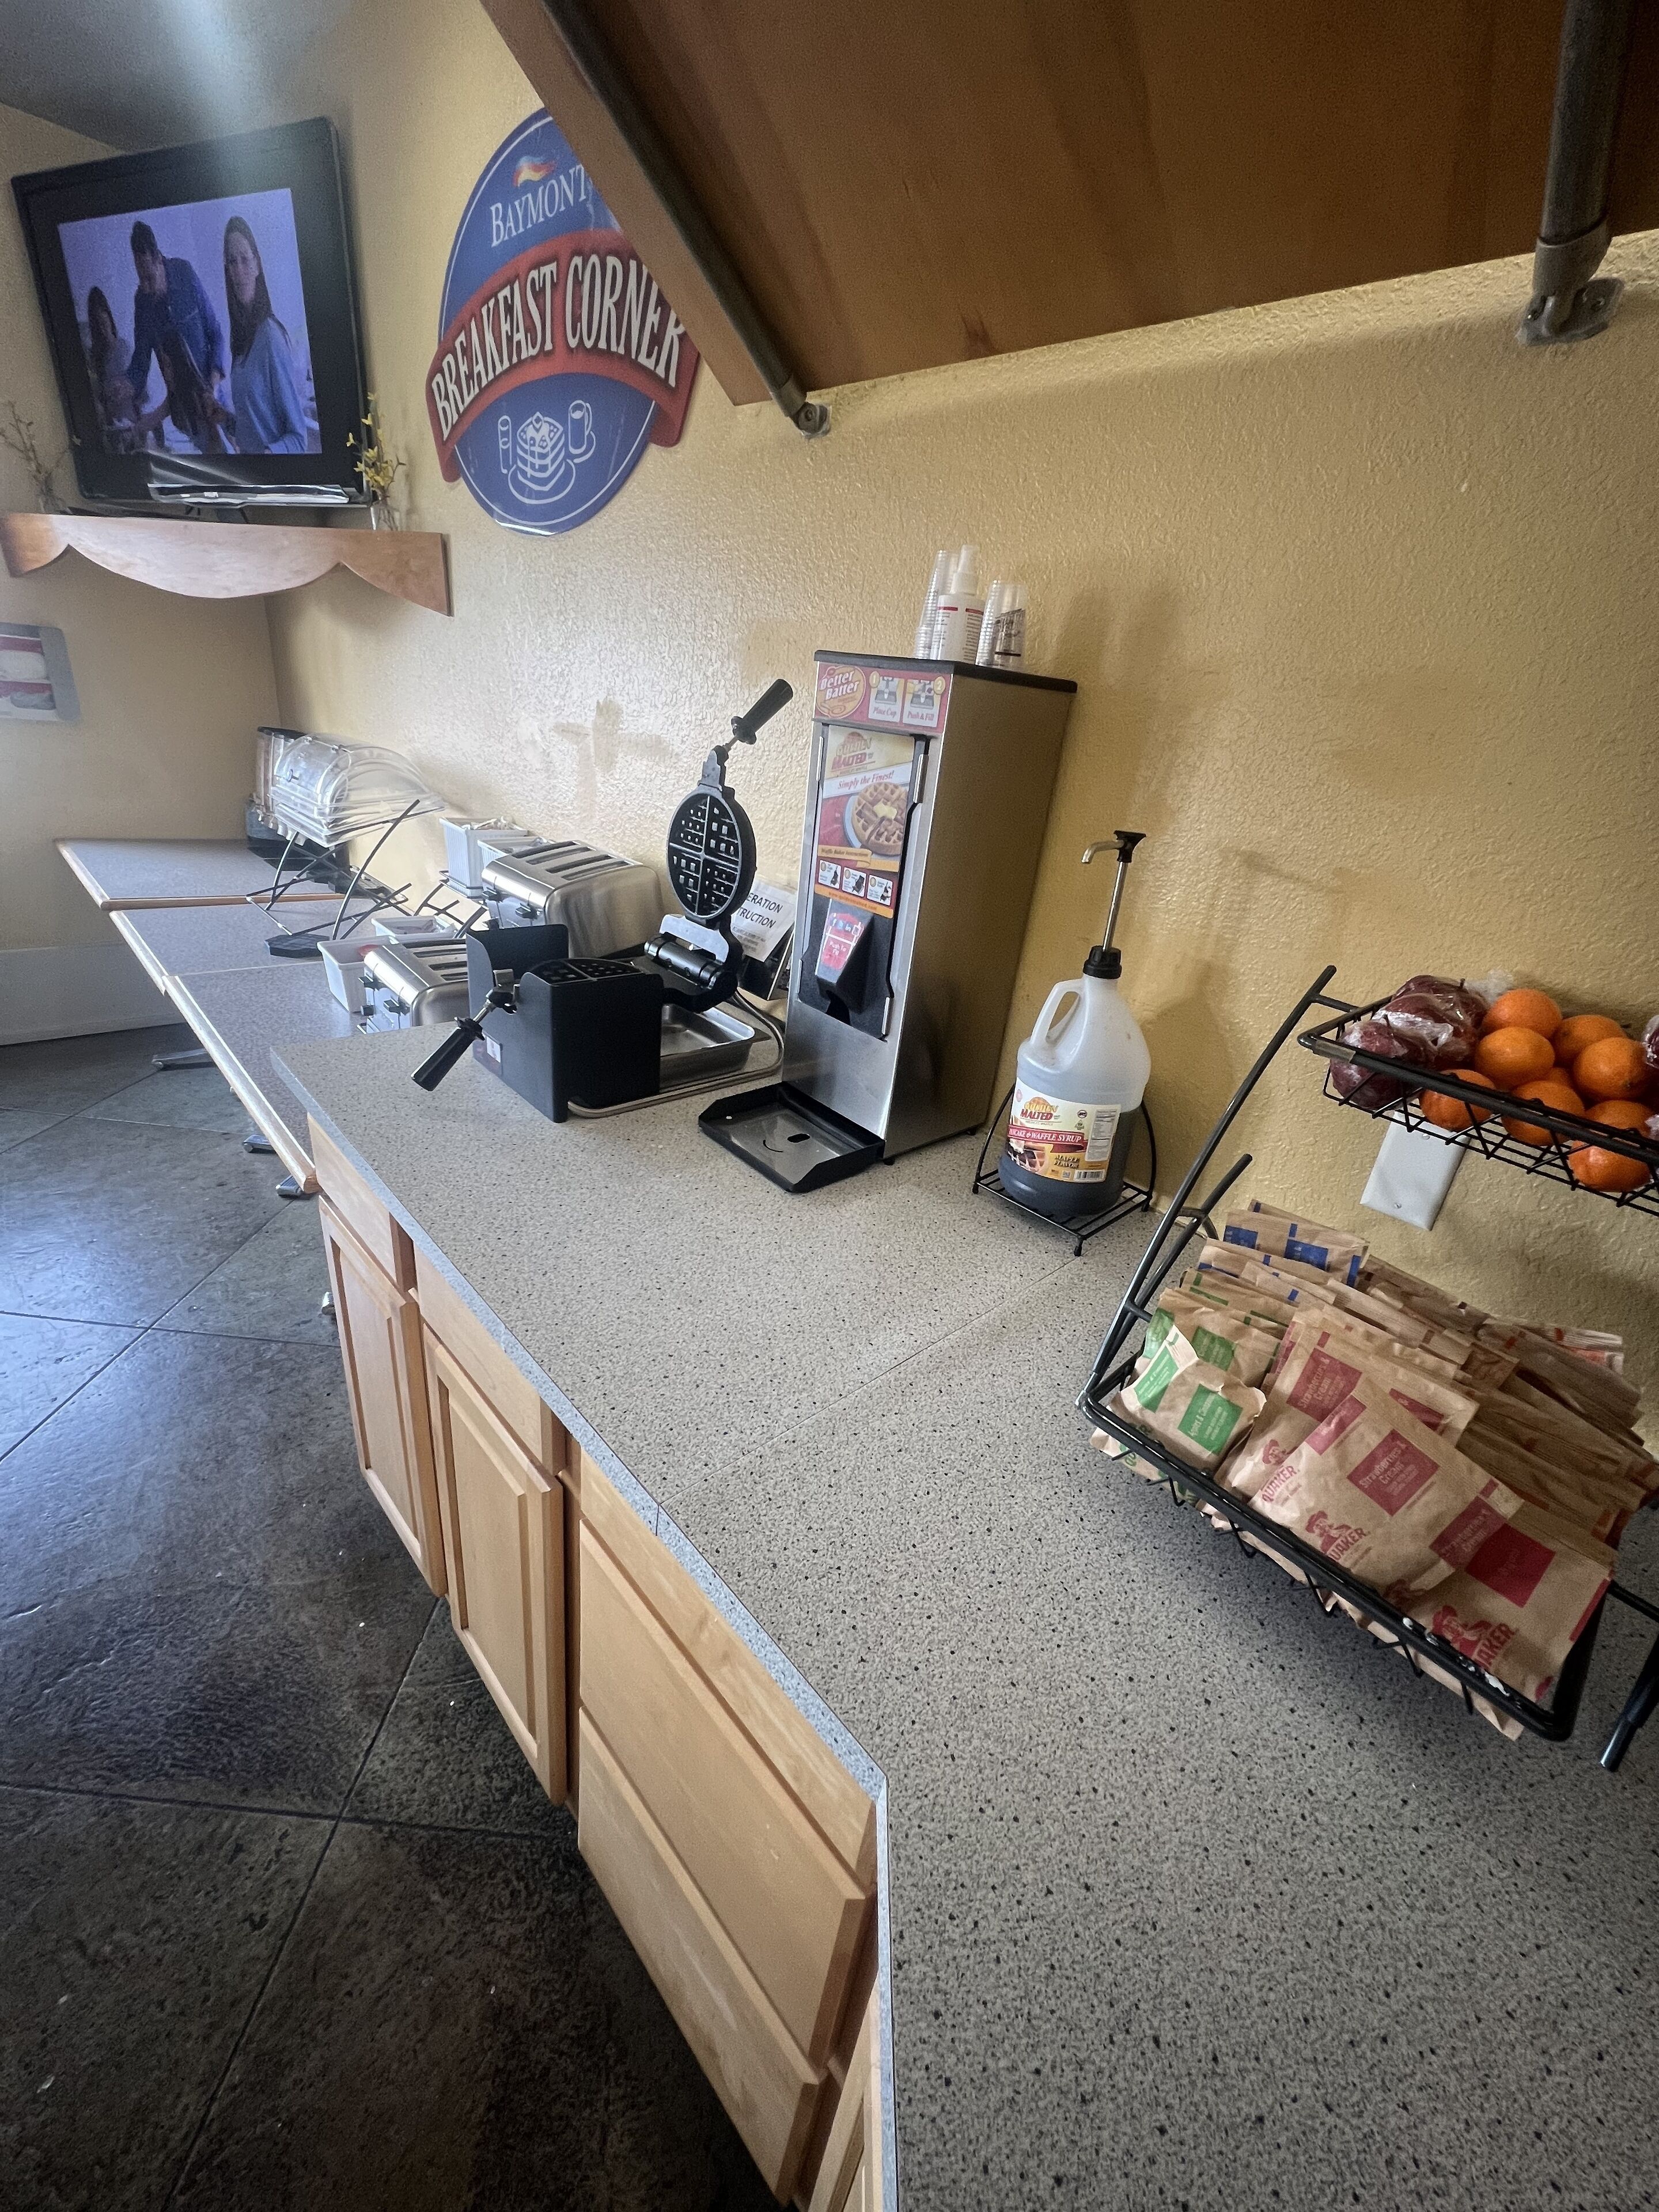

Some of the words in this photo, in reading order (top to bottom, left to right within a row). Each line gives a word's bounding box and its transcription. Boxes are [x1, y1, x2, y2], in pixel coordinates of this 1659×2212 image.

[491, 164, 588, 248] BAYMONT
[431, 261, 558, 442] BREAKFAST
[565, 255, 685, 388] CORNER
[820, 671, 855, 691] Better
[825, 681, 859, 700] Batter
[831, 752, 867, 770] MALTED
[838, 776, 859, 790] Simply
[860, 774, 870, 785] the
[871, 770, 895, 782] Finest!
[747, 893, 783, 914] ERATION
[737, 907, 777, 929] TRUCTION
[1020, 1108, 1054, 1120] MALTED
[1031, 1132, 1057, 1141] WAFFLE
[1057, 1134, 1082, 1143] SYRUP
[1055, 1154, 1081, 1163] MAPLE
[1262, 1465, 1297, 1503] QUAKER
[1328, 1528, 1366, 1560] UAKER
[1474, 1622, 1515, 1671] AKER
